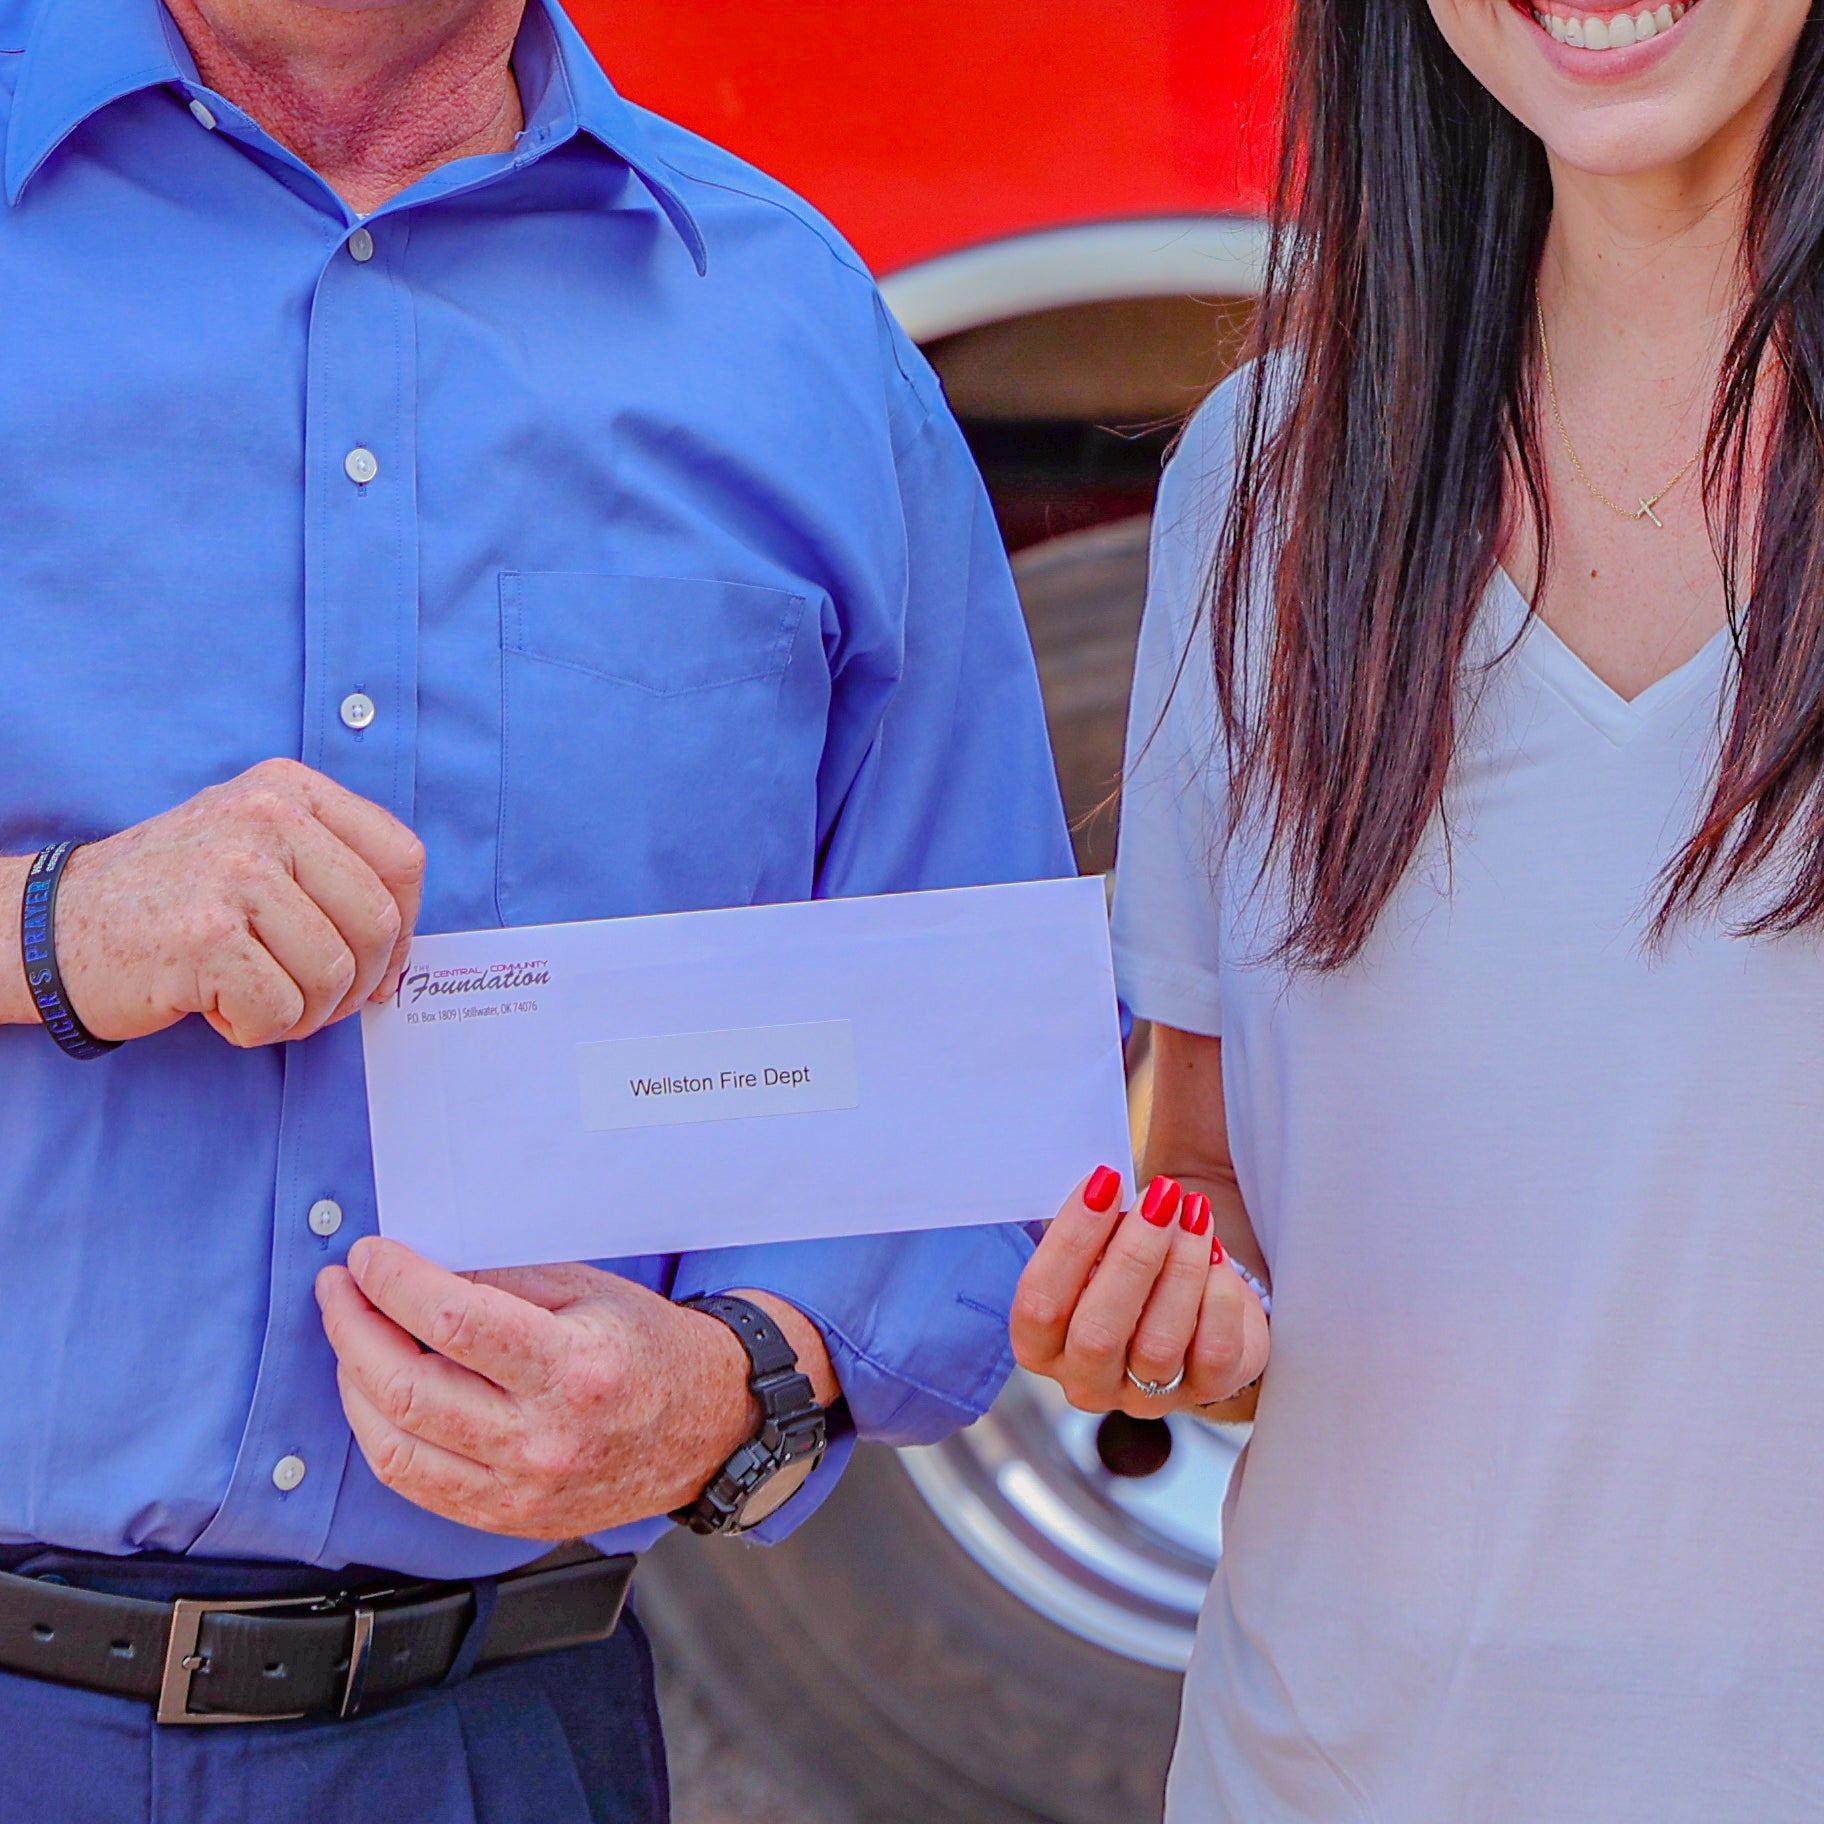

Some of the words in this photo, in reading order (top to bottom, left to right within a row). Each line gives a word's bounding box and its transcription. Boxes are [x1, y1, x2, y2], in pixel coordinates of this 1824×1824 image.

[24, 879, 52, 963] PRAYER
[433, 967, 483, 979] CENTRAL
[490, 960, 549, 974] COMMUNITY
[406, 969, 552, 1004] Foundation
[422, 1010, 436, 1023] Box
[438, 1008, 457, 1021] 1809
[500, 1001, 512, 1014] OK
[513, 1000, 538, 1013] 74076
[629, 1077, 713, 1097] Wellston
[720, 1071, 758, 1089] Fire
[764, 1066, 811, 1088] Dept
